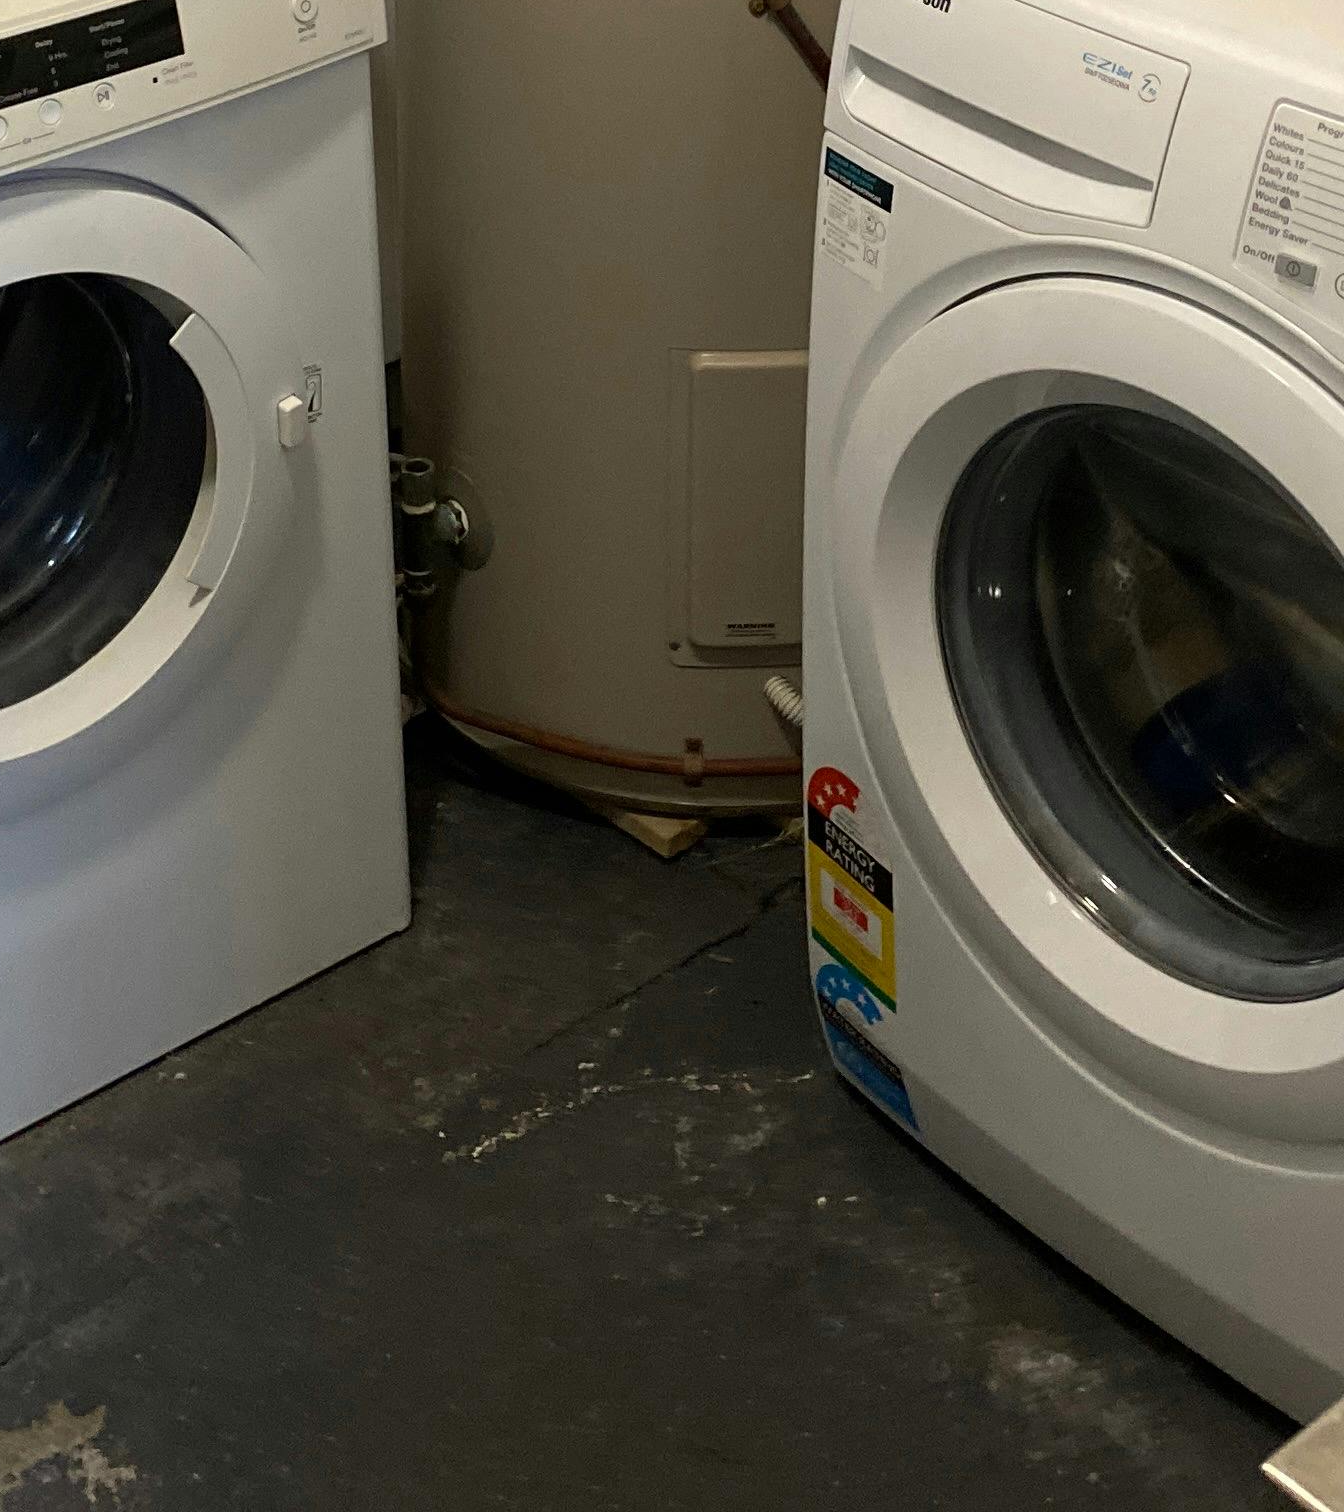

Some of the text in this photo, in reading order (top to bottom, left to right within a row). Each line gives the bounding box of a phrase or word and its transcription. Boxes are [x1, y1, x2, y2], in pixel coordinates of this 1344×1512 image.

[1273, 123, 1304, 141] Whites
[1269, 136, 1304, 155] Colours
[1262, 162, 1285, 178] Daily
[1265, 149, 1305, 170] Quick 15
[1255, 189, 1278, 204] Wool
[1258, 176, 1300, 198] Delicates
[1252, 202, 1289, 225] Bedding
[1248, 216, 1308, 246] Energy Saver
[1243, 245, 1275, 264] On/Off
[825, 821, 875, 873] ENERGY
[825, 839, 875, 892] RATING
